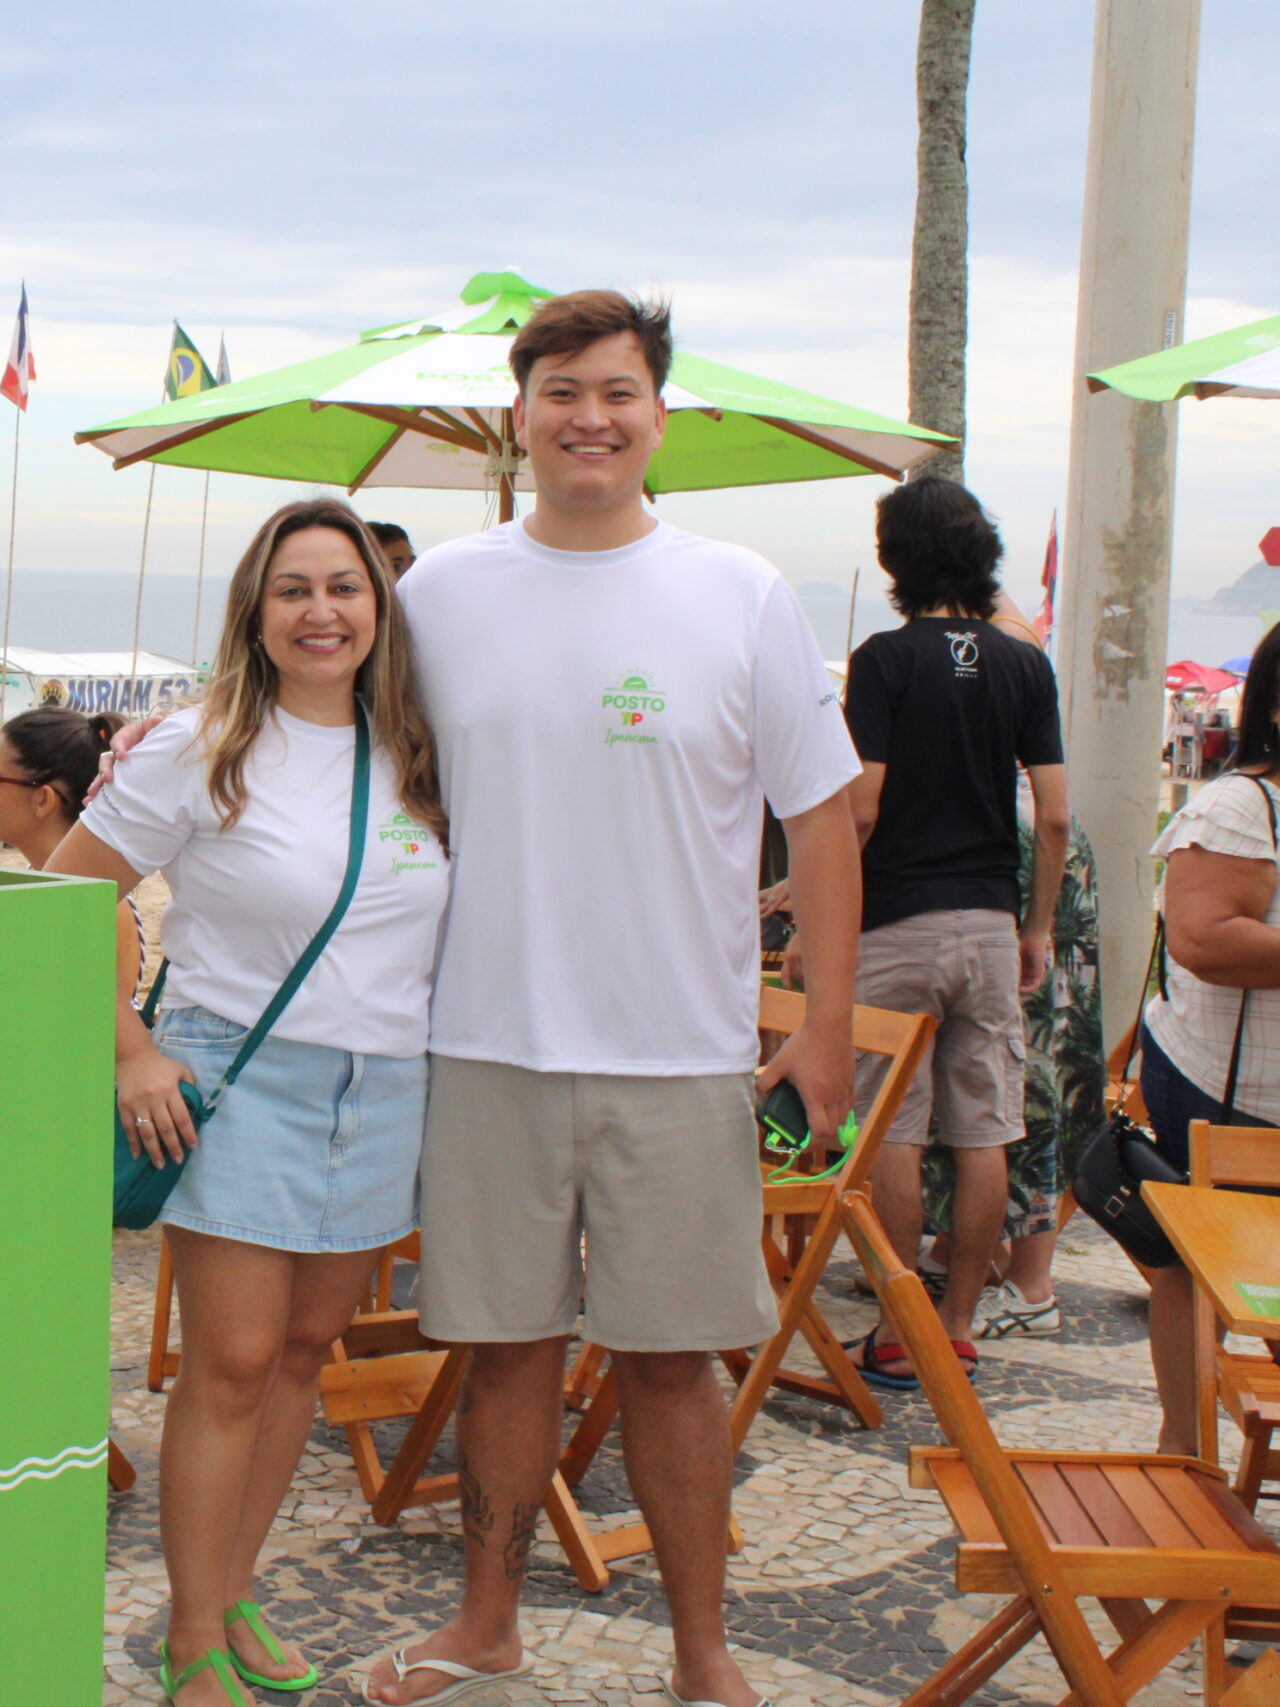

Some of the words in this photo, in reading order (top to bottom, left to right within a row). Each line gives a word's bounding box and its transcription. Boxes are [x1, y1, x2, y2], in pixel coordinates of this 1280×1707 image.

[416, 372, 515, 382] POST
[65, 679, 154, 713] MIRIAM
[601, 695, 665, 712] POSTO
[378, 829, 429, 842] POSTO
